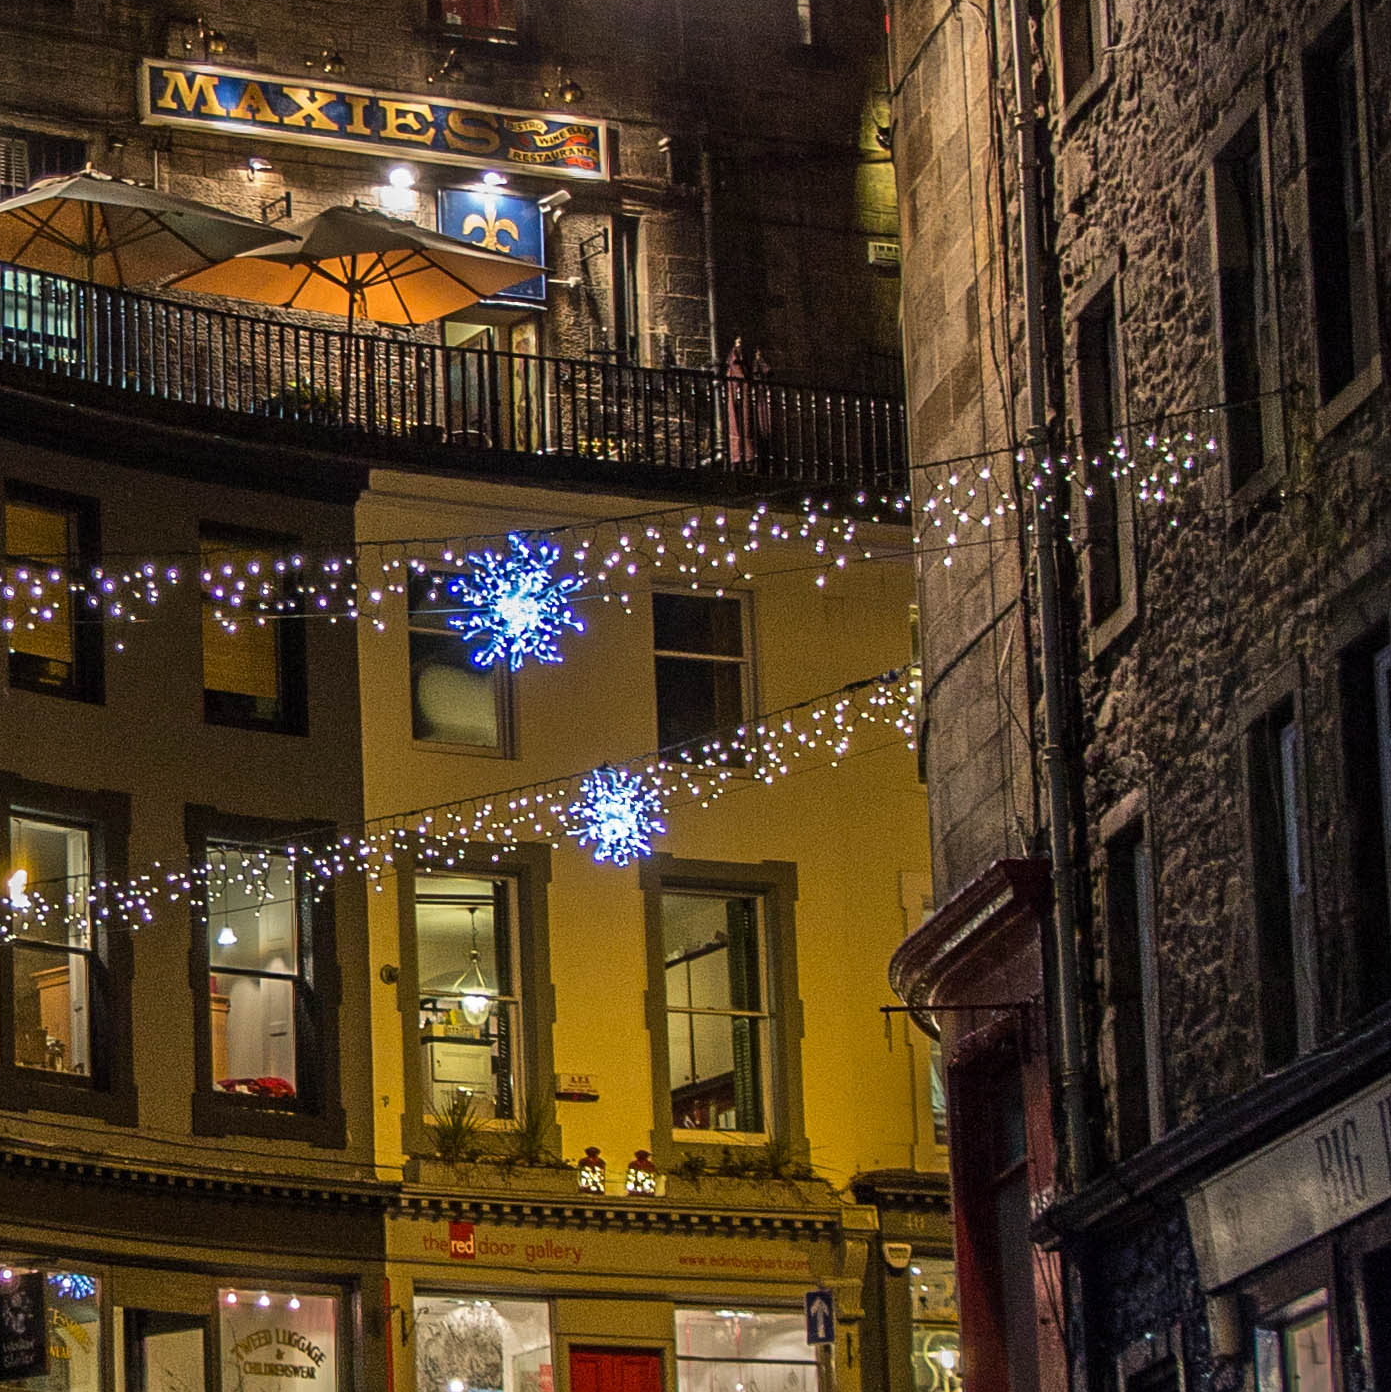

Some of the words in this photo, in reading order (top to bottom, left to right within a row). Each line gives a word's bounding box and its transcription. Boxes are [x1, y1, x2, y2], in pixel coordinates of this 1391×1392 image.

[157, 69, 502, 154] MAXIES
[512, 147, 593, 161] RESTAURANT
[539, 132, 566, 146] WINE
[1315, 1117, 1368, 1211] BIG
[422, 1232, 448, 1252] the
[451, 1233, 474, 1254] red
[477, 1235, 516, 1255] door
[524, 1239, 584, 1265] gallery
[231, 1329, 272, 1361] TWEED
[275, 1329, 326, 1367] LUGGAGE
